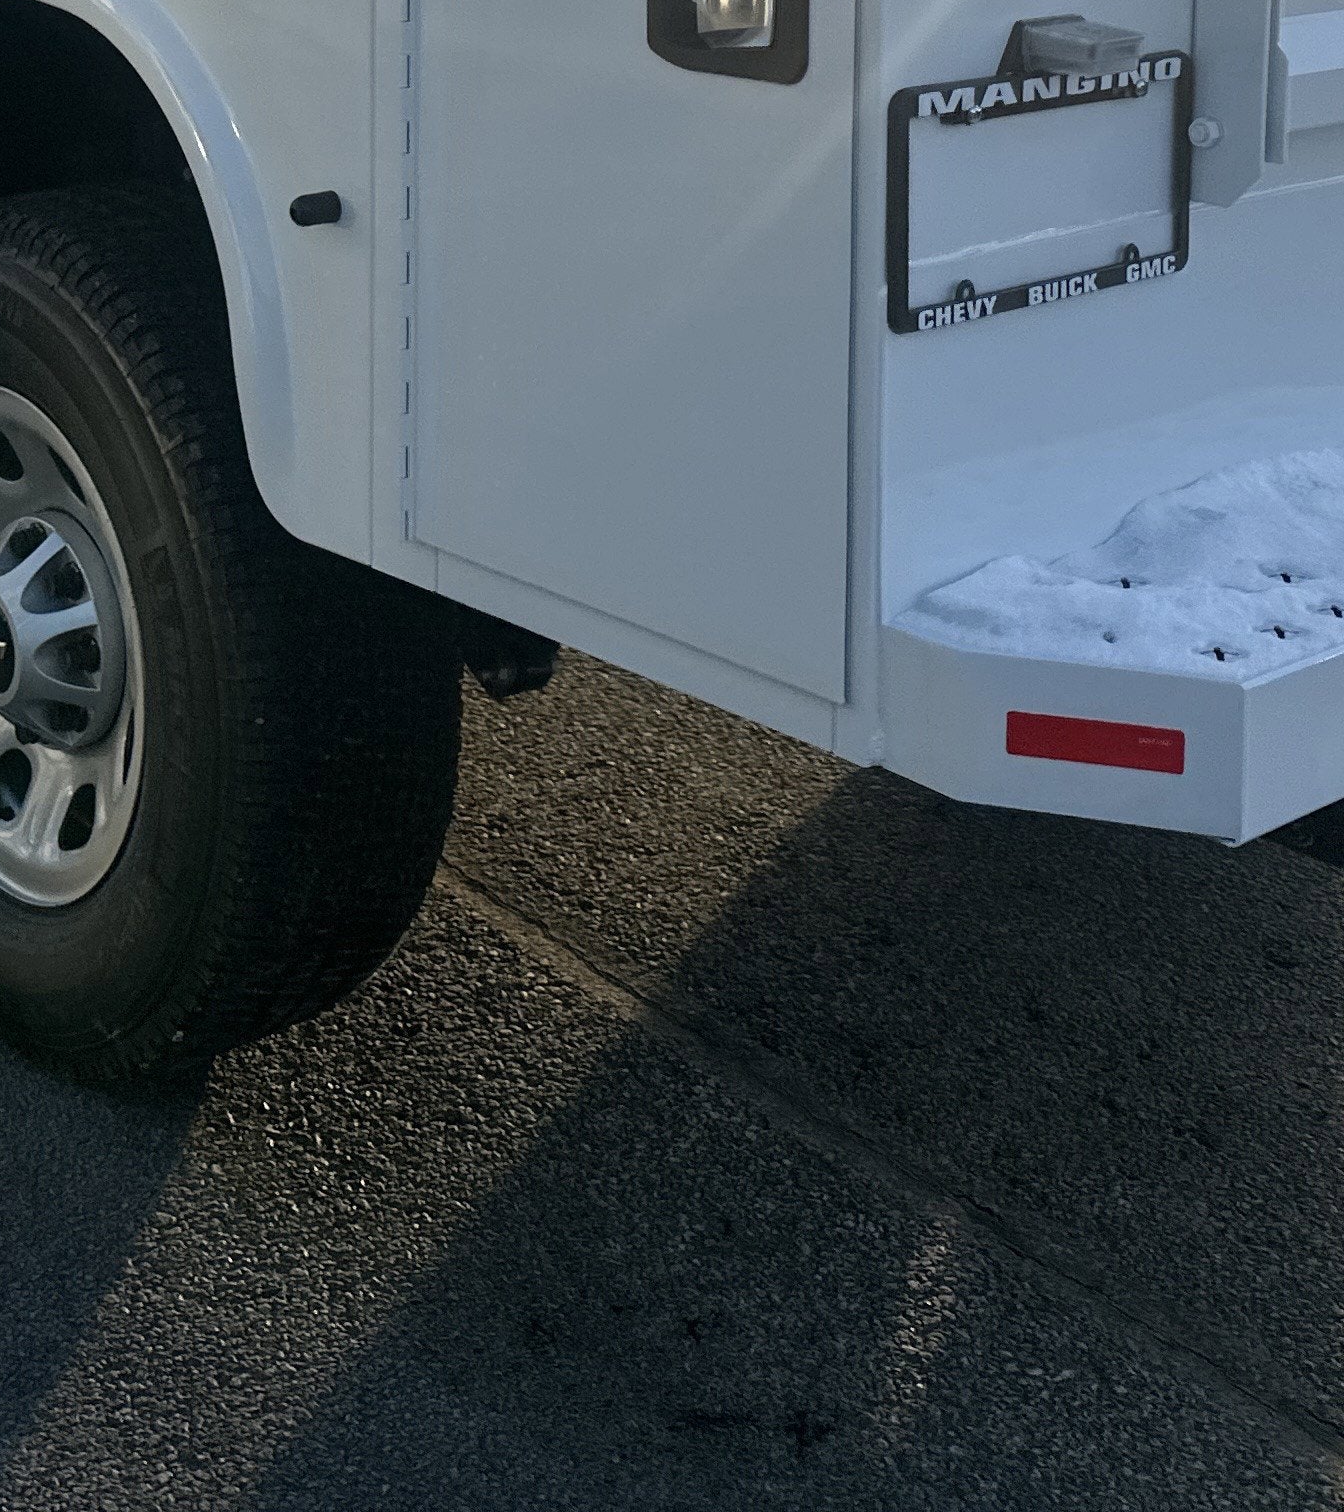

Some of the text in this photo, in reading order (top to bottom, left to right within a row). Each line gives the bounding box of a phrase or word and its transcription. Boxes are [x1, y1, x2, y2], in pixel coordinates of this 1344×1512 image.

[917, 255, 1176, 330] CHEVY BUICK GMC
